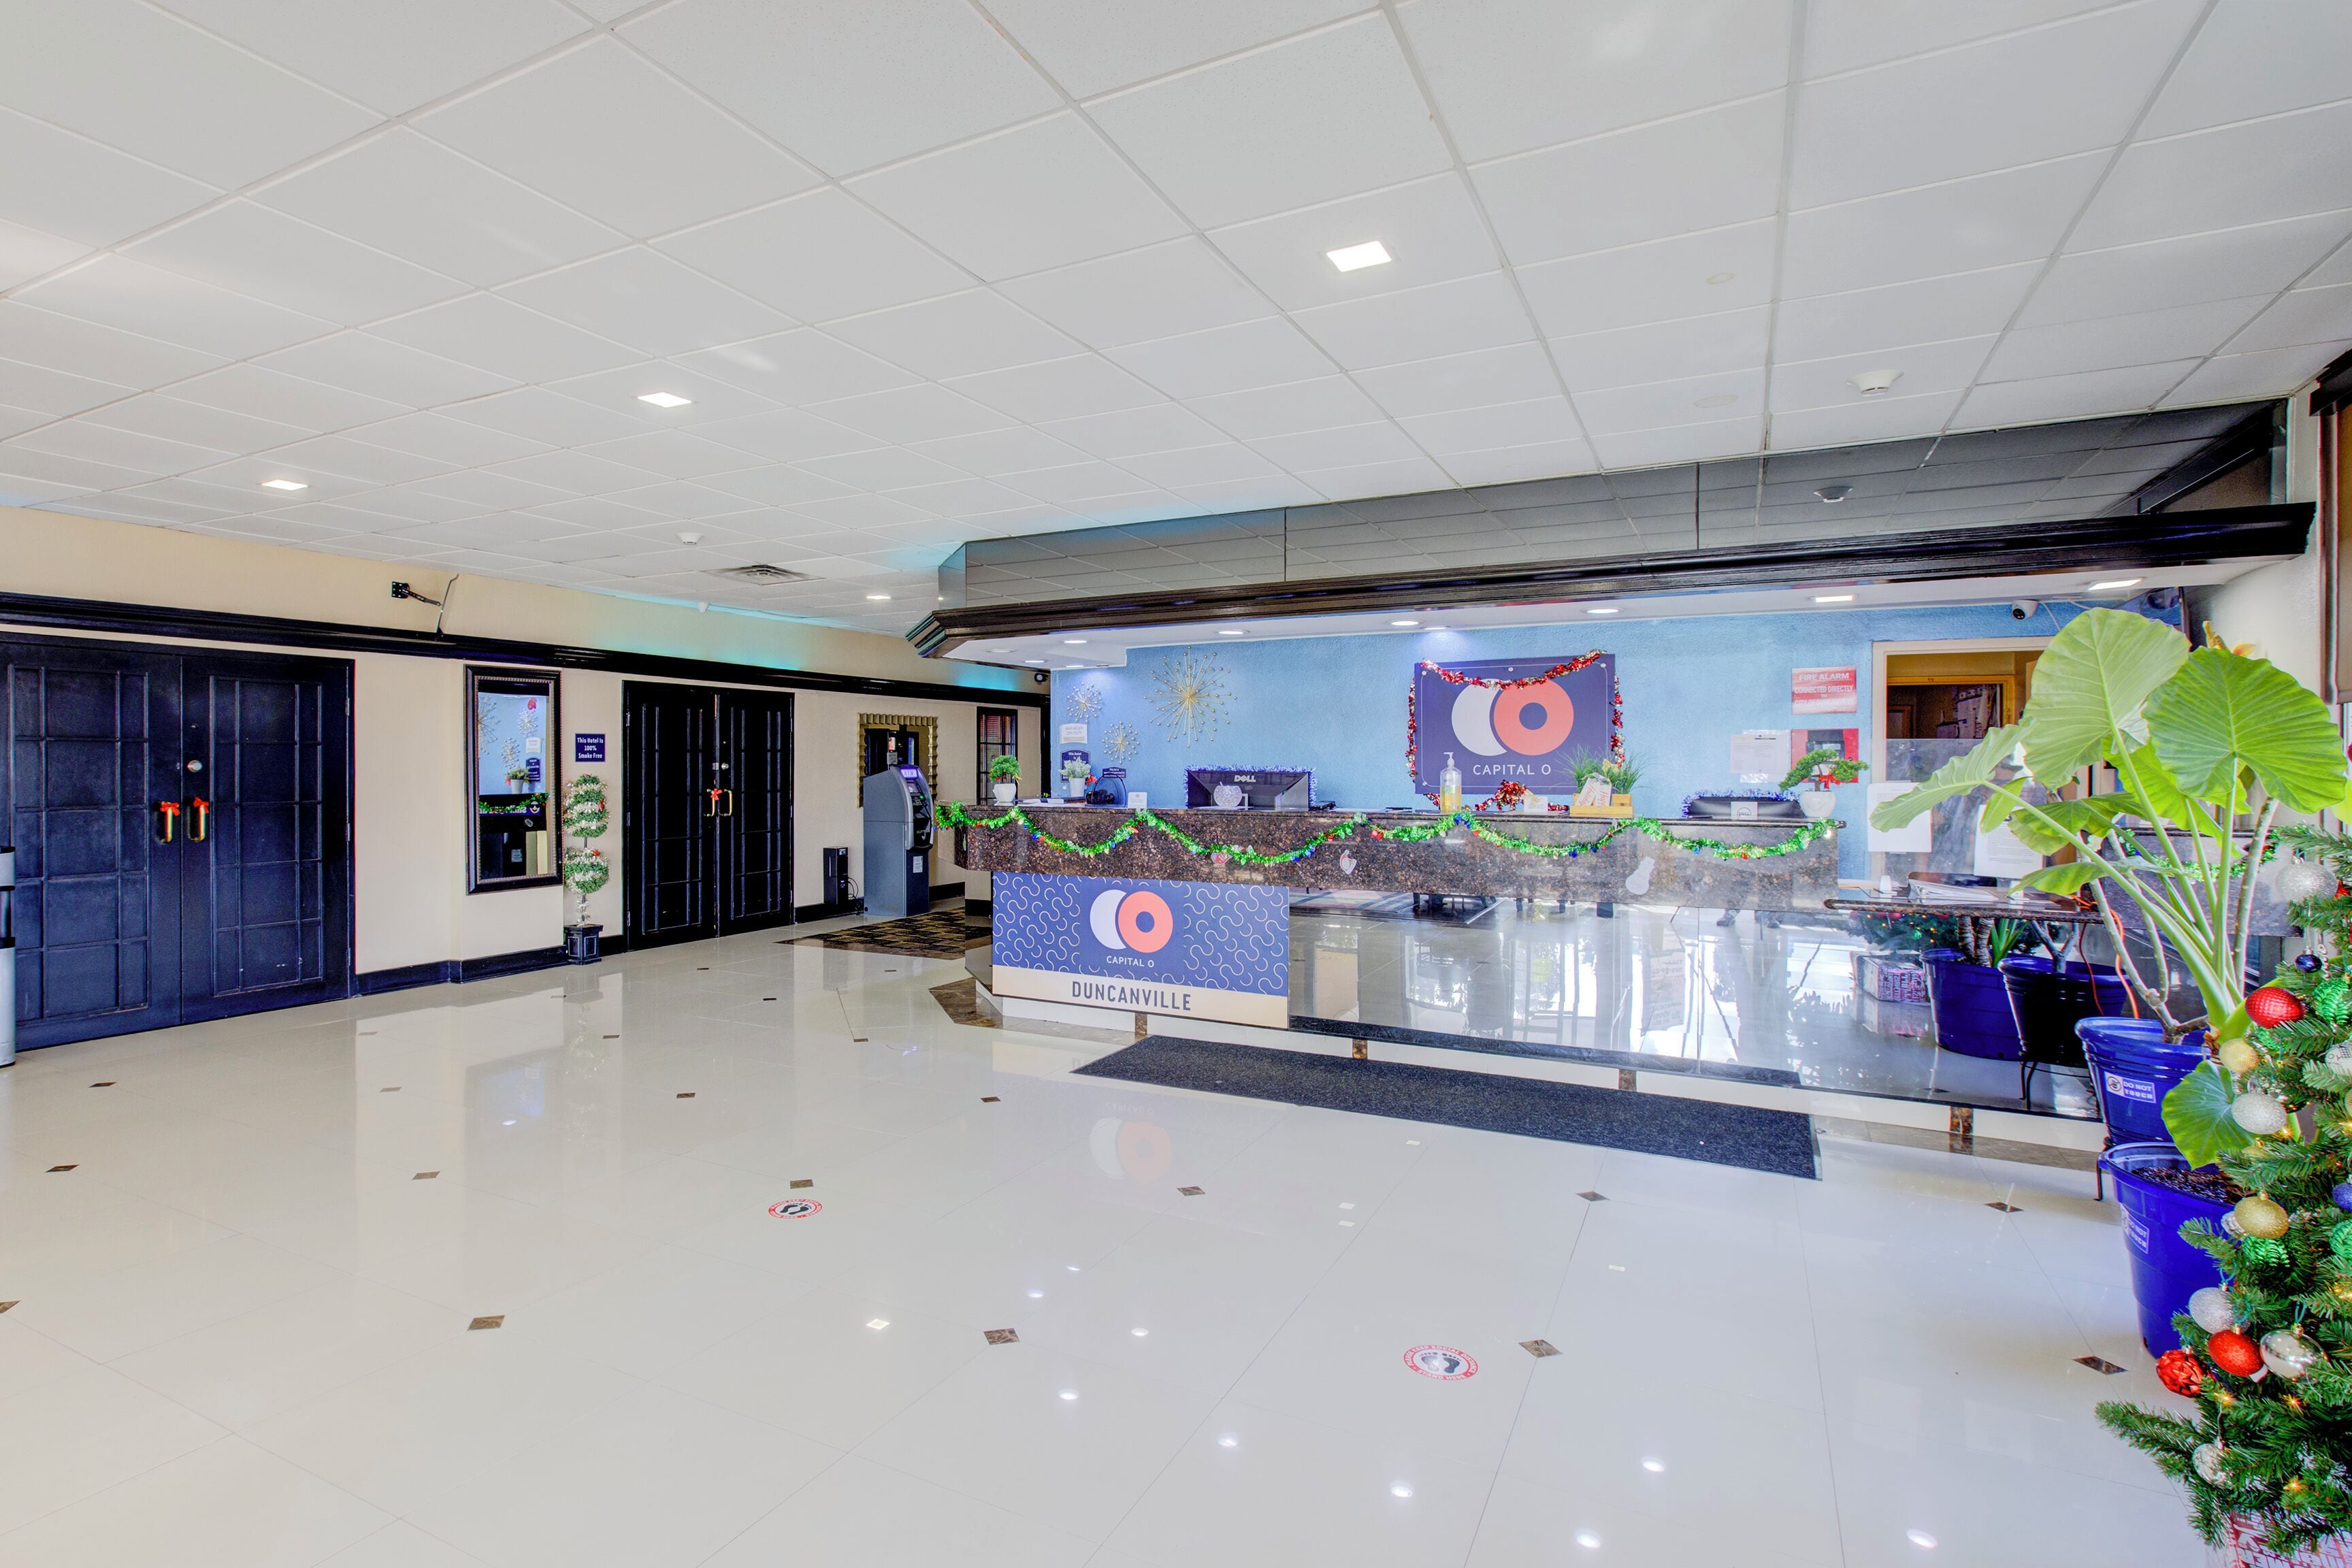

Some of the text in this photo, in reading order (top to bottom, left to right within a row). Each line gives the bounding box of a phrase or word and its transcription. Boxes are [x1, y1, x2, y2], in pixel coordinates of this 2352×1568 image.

[1827, 685, 1853, 693] DIRECTLY
[1473, 764, 1552, 775] CAPITAL O
[1106, 956, 1154, 968] CAPITAL O
[1072, 981, 1192, 1011] DUNCANVILLE
[2135, 1083, 2152, 1092] NOT
[2124, 1089, 2153, 1099] TOUCH
[1431, 1345, 1460, 1355] SOCIAL
[1417, 1369, 1445, 1379] STAND
